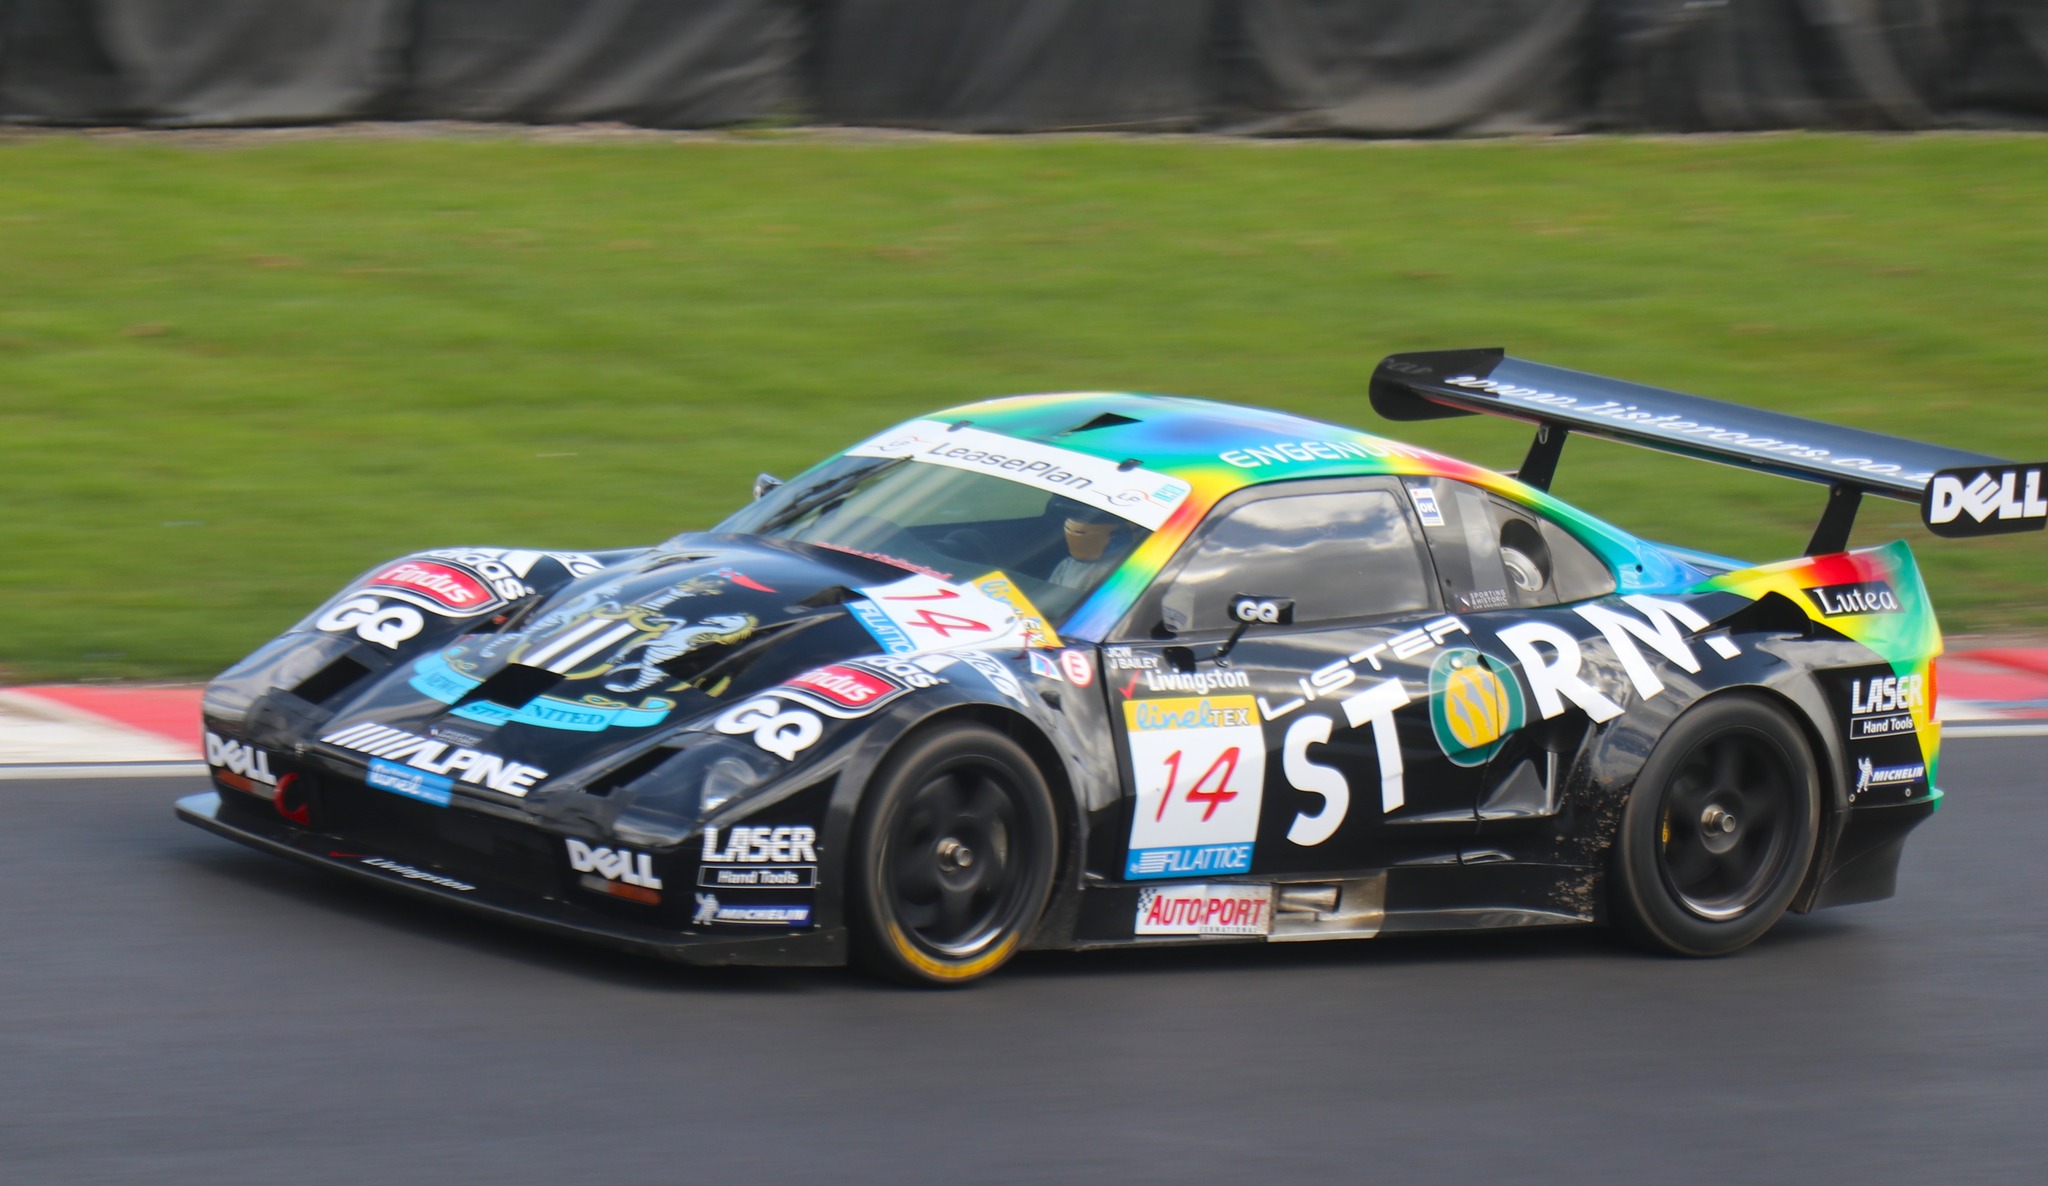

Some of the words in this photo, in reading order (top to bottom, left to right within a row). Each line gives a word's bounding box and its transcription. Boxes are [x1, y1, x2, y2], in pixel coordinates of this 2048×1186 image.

[928, 442, 1093, 489] LeasePlan
[1420, 503, 1436, 512] OK
[1930, 470, 2047, 524] DELL
[378, 563, 475, 603] Findus
[1469, 589, 1506, 600] SPORTING
[1237, 601, 1280, 624] GQ
[1813, 588, 1898, 615] Lutea
[315, 599, 424, 650] GQ
[1119, 658, 1159, 670] BAILEY
[1257, 616, 1470, 721] LISTER
[1145, 669, 1250, 695] Livingston
[1851, 674, 1923, 714] LASER
[714, 699, 823, 762] GQ
[1863, 720, 1889, 734] Hand
[1890, 717, 1914, 731] Tools
[206, 732, 278, 785] DELL
[381, 738, 549, 797] ALPINE
[1872, 765, 1925, 782] MICHELIN
[1155, 746, 1241, 822] 14
[702, 827, 818, 862] LASER
[361, 858, 477, 891] Livingston
[566, 839, 663, 890] DELL
[718, 870, 758, 884] Hand
[760, 870, 800, 884] Tools
[717, 909, 810, 921] MICHELIN
